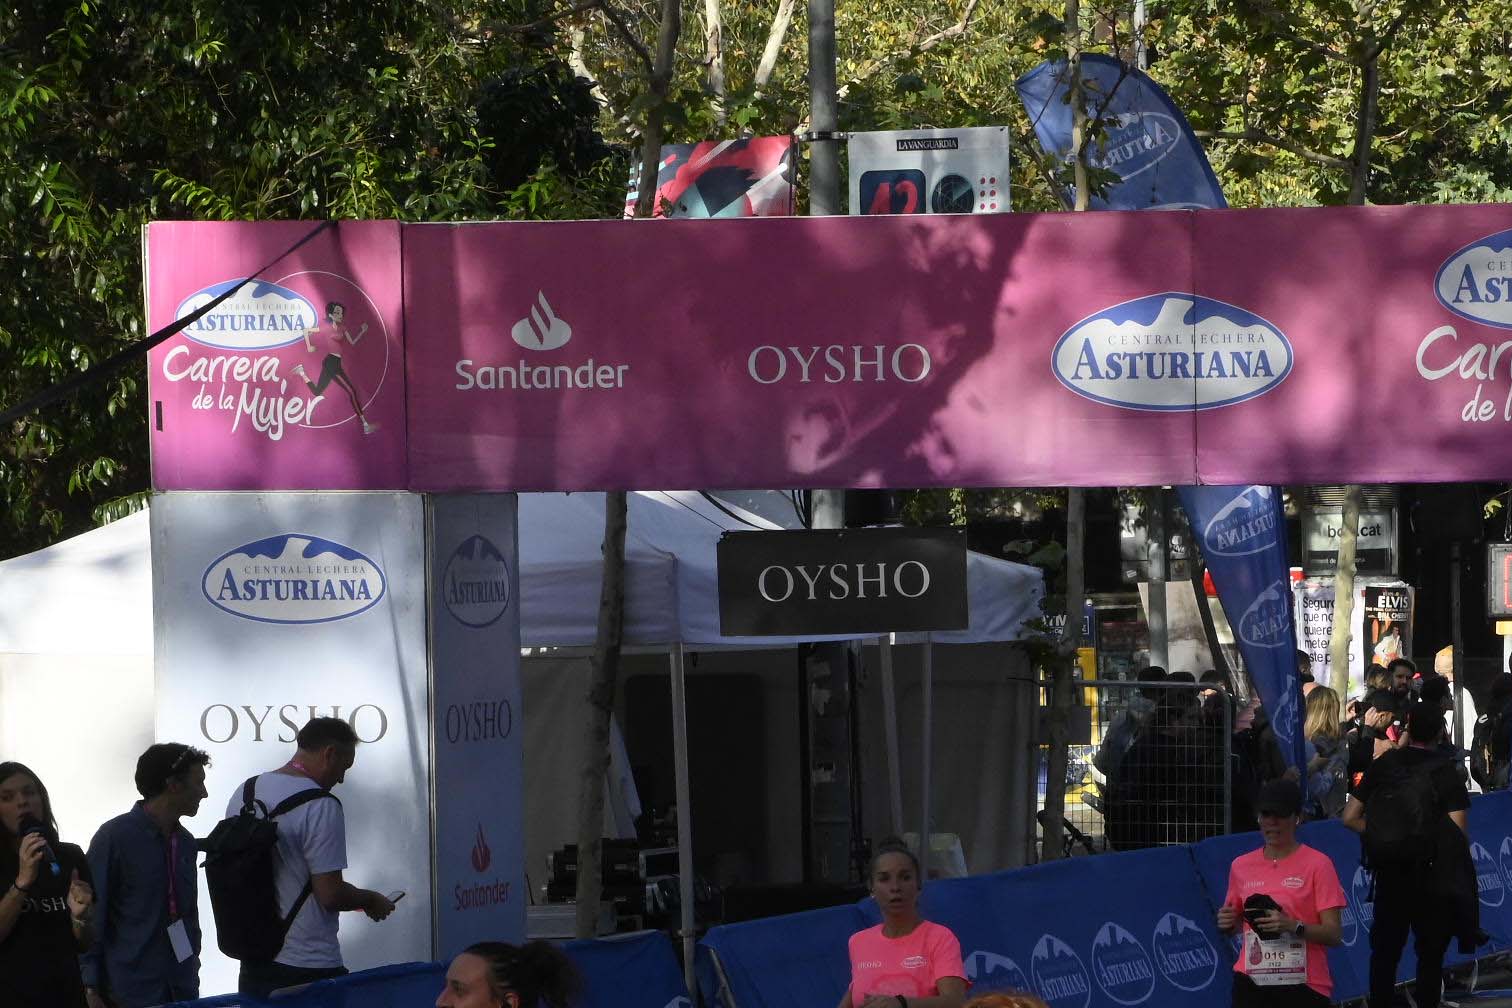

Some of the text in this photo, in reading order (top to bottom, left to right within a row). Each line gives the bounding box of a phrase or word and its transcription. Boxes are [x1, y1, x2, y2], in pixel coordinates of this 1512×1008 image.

[909, 138, 957, 150] VANGUARDIA
[1107, 332, 1266, 345] CENTRAL LECHERA
[163, 345, 280, 382] Carrera
[455, 358, 630, 390] Santander
[748, 342, 931, 385] OYSHO
[1071, 337, 1272, 381] ASTURIANA
[192, 379, 325, 441] de la Mujer
[1461, 383, 1496, 423] de
[216, 568, 373, 601] ASTURIANA
[244, 565, 366, 575] CENTRAL LECHERA
[758, 560, 931, 602] OYSHO
[449, 570, 505, 604] ASTURIANA
[1378, 596, 1408, 608] ELVIS
[1304, 613, 1319, 623] que
[445, 699, 512, 744] OYSHO
[455, 881, 512, 912] Santander
[1264, 951, 1285, 961] 016
[1037, 970, 1088, 1001] ASTURIANA
[1098, 957, 1152, 988] ASTURIANA
